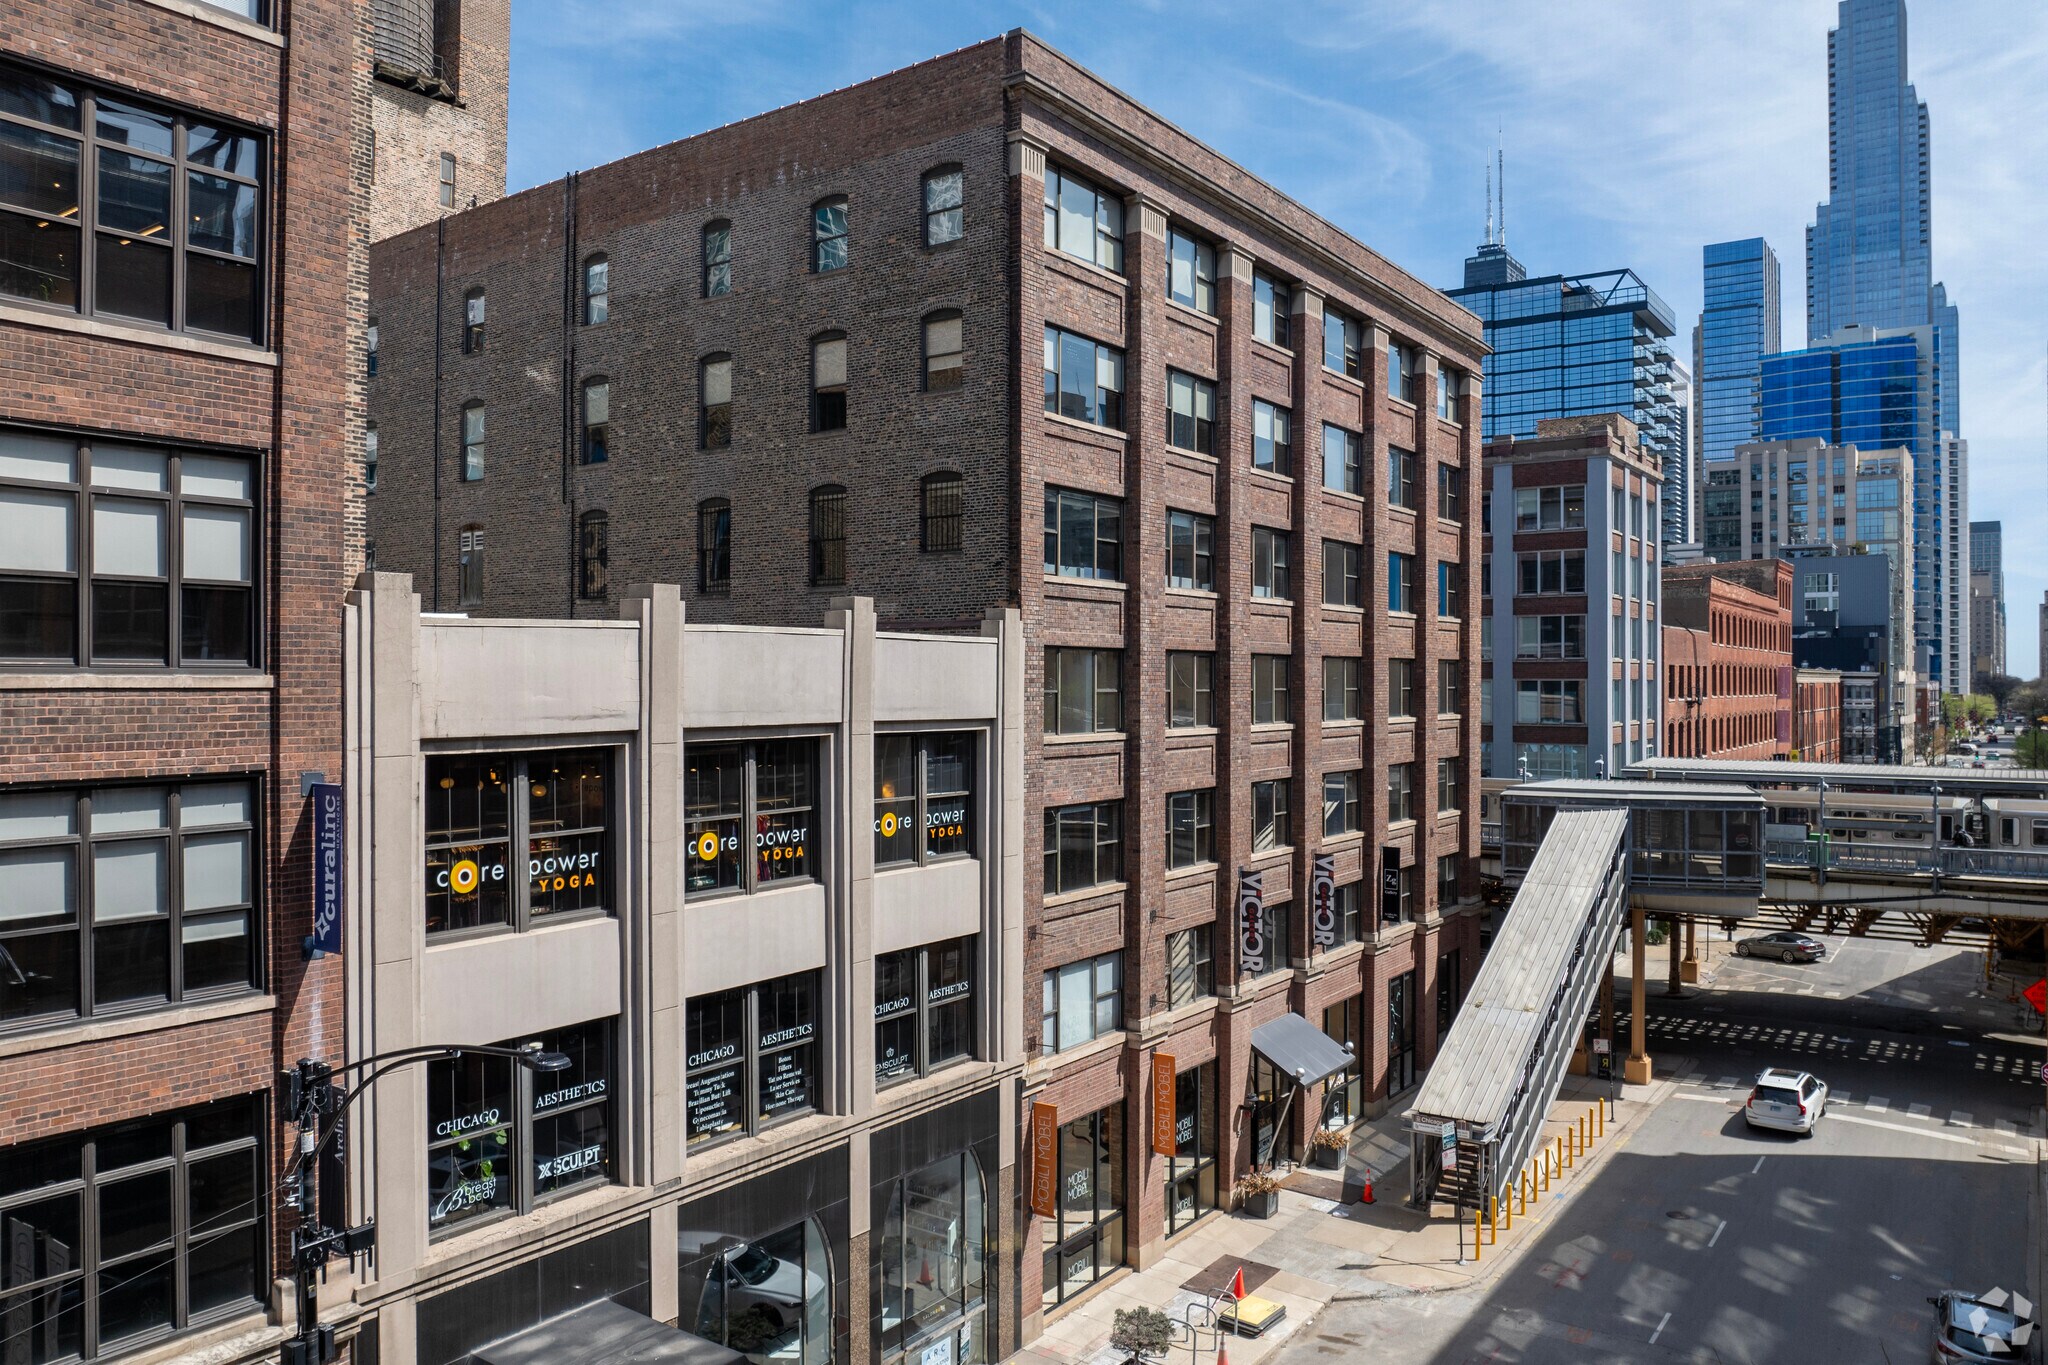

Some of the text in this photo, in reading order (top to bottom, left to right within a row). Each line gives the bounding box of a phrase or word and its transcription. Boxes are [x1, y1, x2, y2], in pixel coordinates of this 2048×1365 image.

[873, 812, 912, 837] core
[930, 825, 963, 838] YOGA
[321, 795, 336, 921] curalinc
[688, 832, 738, 860] core
[762, 846, 804, 861] YOGA
[437, 852, 599, 893] core power
[539, 873, 595, 893] YOGA
[874, 981, 969, 1015] CHICAGO AESTHETICS
[688, 1023, 813, 1067] CHICAGO AESTHETICS
[767, 1075, 783, 1084] Tatoo
[436, 1079, 606, 1136] CHICAGO AESTHETICS
[1159, 1107, 1171, 1149] MOBILI
[464, 1177, 497, 1197] breast
[1037, 1165, 1050, 1212] MOBILI
[1067, 1167, 1089, 1188] MOBILI
[468, 1188, 497, 1205] body
